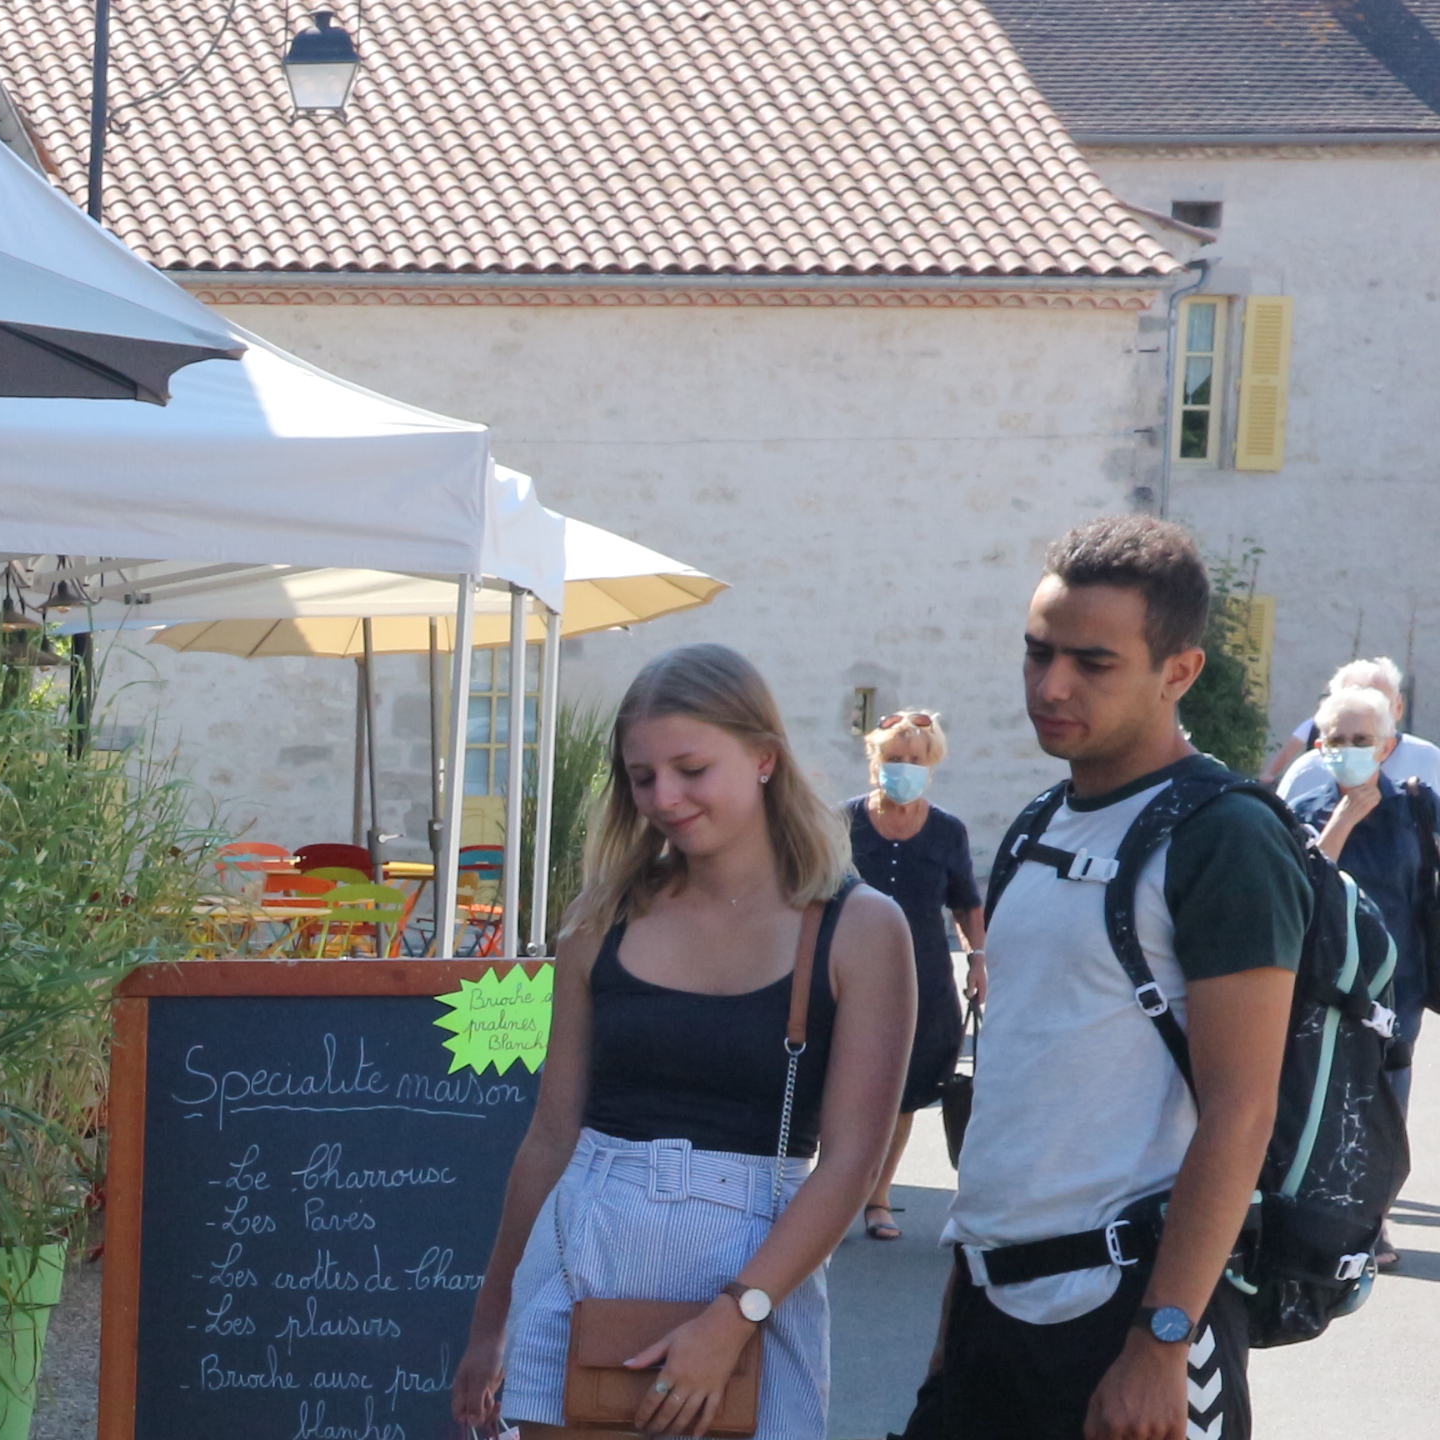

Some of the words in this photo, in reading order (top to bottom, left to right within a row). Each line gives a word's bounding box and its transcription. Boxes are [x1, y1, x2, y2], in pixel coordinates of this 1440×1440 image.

[469, 982, 536, 1013] Brioche
[462, 1009, 538, 1045] pralines
[396, 1072, 526, 1107] maison
[274, 1248, 360, 1291] crottes
[365, 1244, 400, 1292] de
[200, 1344, 301, 1391] Brioche
